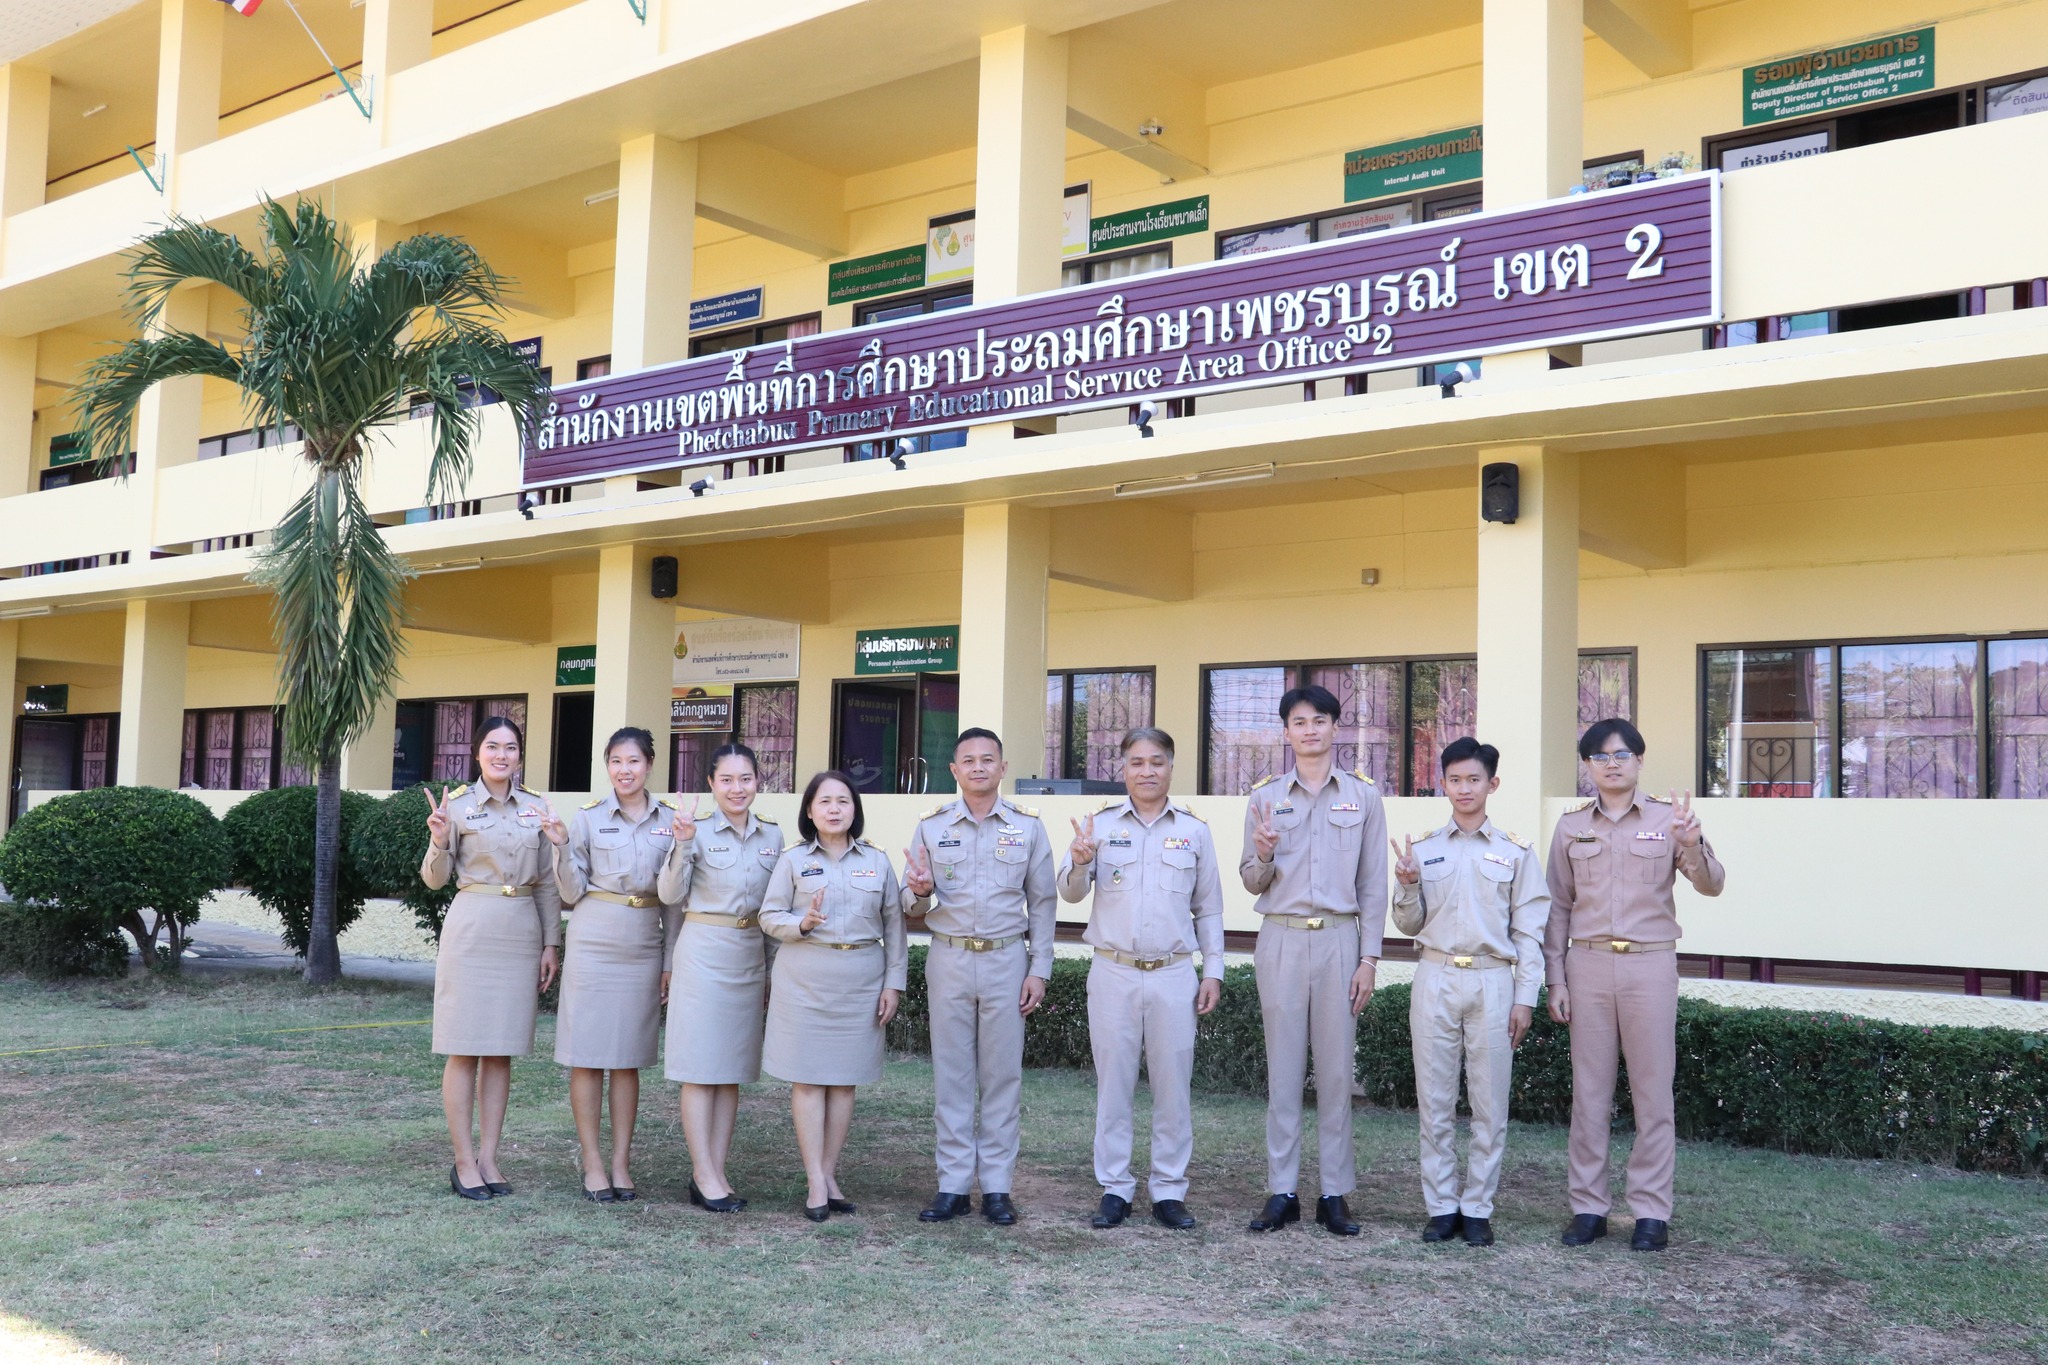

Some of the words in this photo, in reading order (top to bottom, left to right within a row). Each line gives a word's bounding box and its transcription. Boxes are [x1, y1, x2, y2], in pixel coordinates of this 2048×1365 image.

[1755, 35, 1919, 84] รองผู้อำนวยการ
[1918, 55, 1925, 64] 2
[1752, 97, 1781, 110] Deputy
[1784, 91, 1818, 104] Director
[1821, 88, 1830, 96] of
[1833, 76, 1885, 94] Phetchabun
[1888, 68, 1924, 82] Primary
[1774, 99, 1823, 116] Educational
[1826, 93, 1859, 106] Service
[1862, 87, 1888, 98] Office
[1891, 84, 1898, 92] 2
[1384, 173, 1409, 186] Internal
[1411, 171, 1429, 181] Audit
[1431, 168, 1445, 177] Unit
[1092, 201, 1208, 249] ศูนย์ประสานงานโรงเรียนขนาดเล็ก
[538, 237, 1463, 450] สำนักงานเขตพื้นที่การศึกษาประถมศึกษาเพชรบูรณ์
[1493, 243, 1590, 300] เขต
[1625, 223, 1666, 281] 2
[678, 418, 798, 456] Phetchabun
[807, 405, 898, 437] Primary
[907, 374, 1055, 422] Educational
[1064, 366, 1163, 400] Service
[1174, 353, 1245, 385] Area
[1258, 335, 1352, 373] Office
[1372, 323, 1394, 356] 2
[856, 635, 954, 658] กลุ่มบริหารงานบุคคล
[892, 658, 927, 666] Administration
[928, 657, 943, 665] Group
